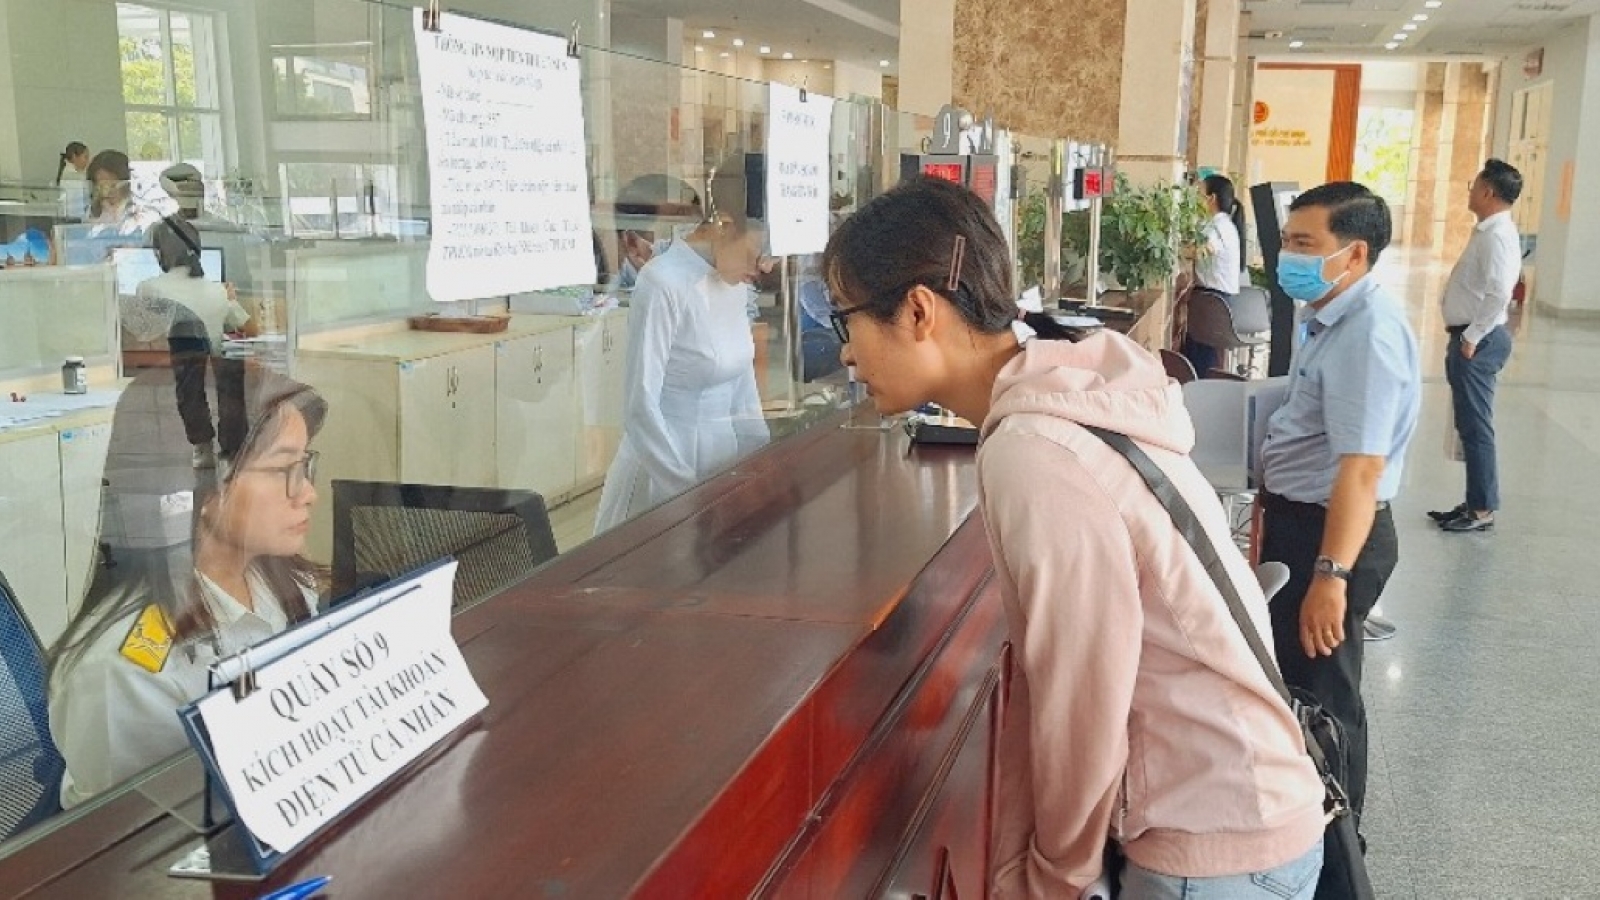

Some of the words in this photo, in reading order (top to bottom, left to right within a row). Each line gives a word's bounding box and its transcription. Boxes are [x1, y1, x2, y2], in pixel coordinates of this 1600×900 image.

[942, 112, 951, 149] 9
[241, 739, 302, 793] KÍCH
[299, 705, 354, 756] HOẠT
[352, 684, 389, 719] TÀI
[385, 648, 448, 700] KHOẢN
[270, 657, 340, 722] QUẦY
[340, 633, 374, 678] SỐ
[373, 631, 389, 658] 9
[275, 767, 339, 828] ĐIỆN
[371, 718, 404, 762] CÁ
[398, 687, 456, 742] NHÂN
